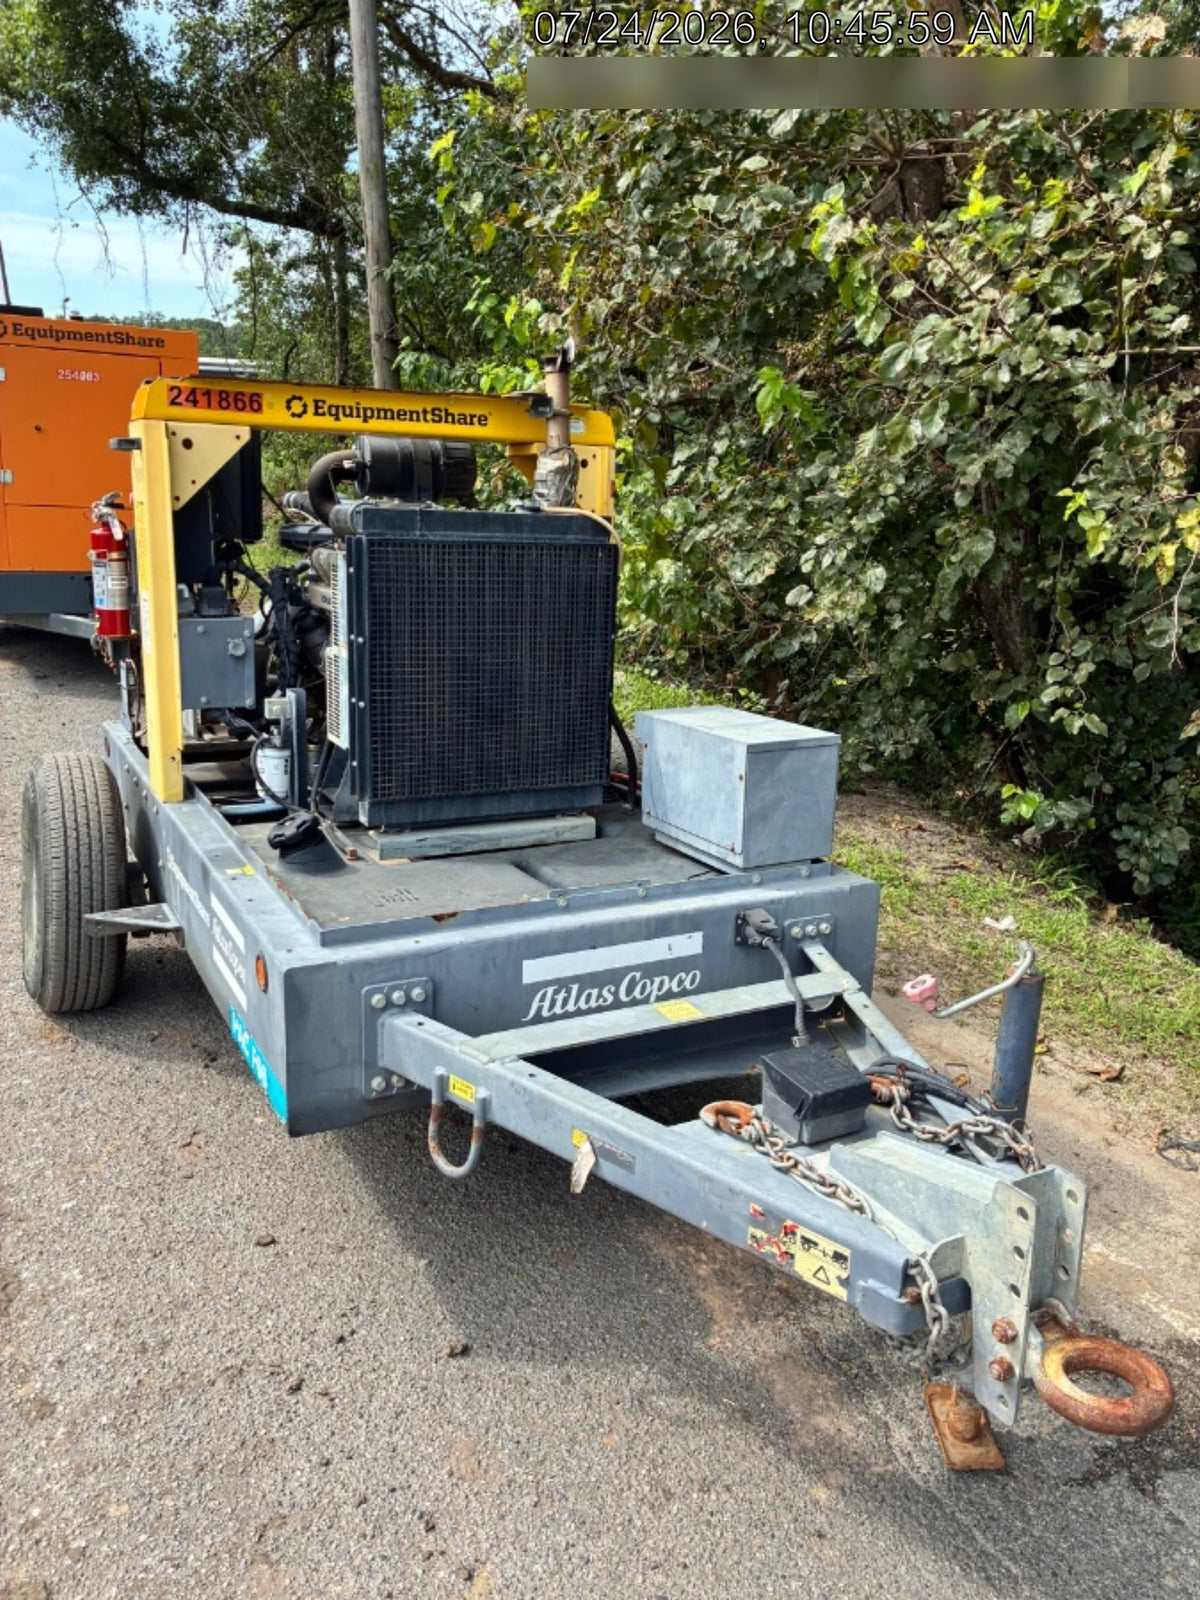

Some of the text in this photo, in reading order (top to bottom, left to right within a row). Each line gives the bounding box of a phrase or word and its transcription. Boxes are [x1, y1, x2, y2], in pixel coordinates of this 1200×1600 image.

[12, 323, 165, 348] EquipmentShare
[168, 385, 263, 413] 241866
[313, 399, 488, 426] EquipmentShare
[522, 984, 615, 1021] Atlas
[618, 970, 701, 1003] Copco
